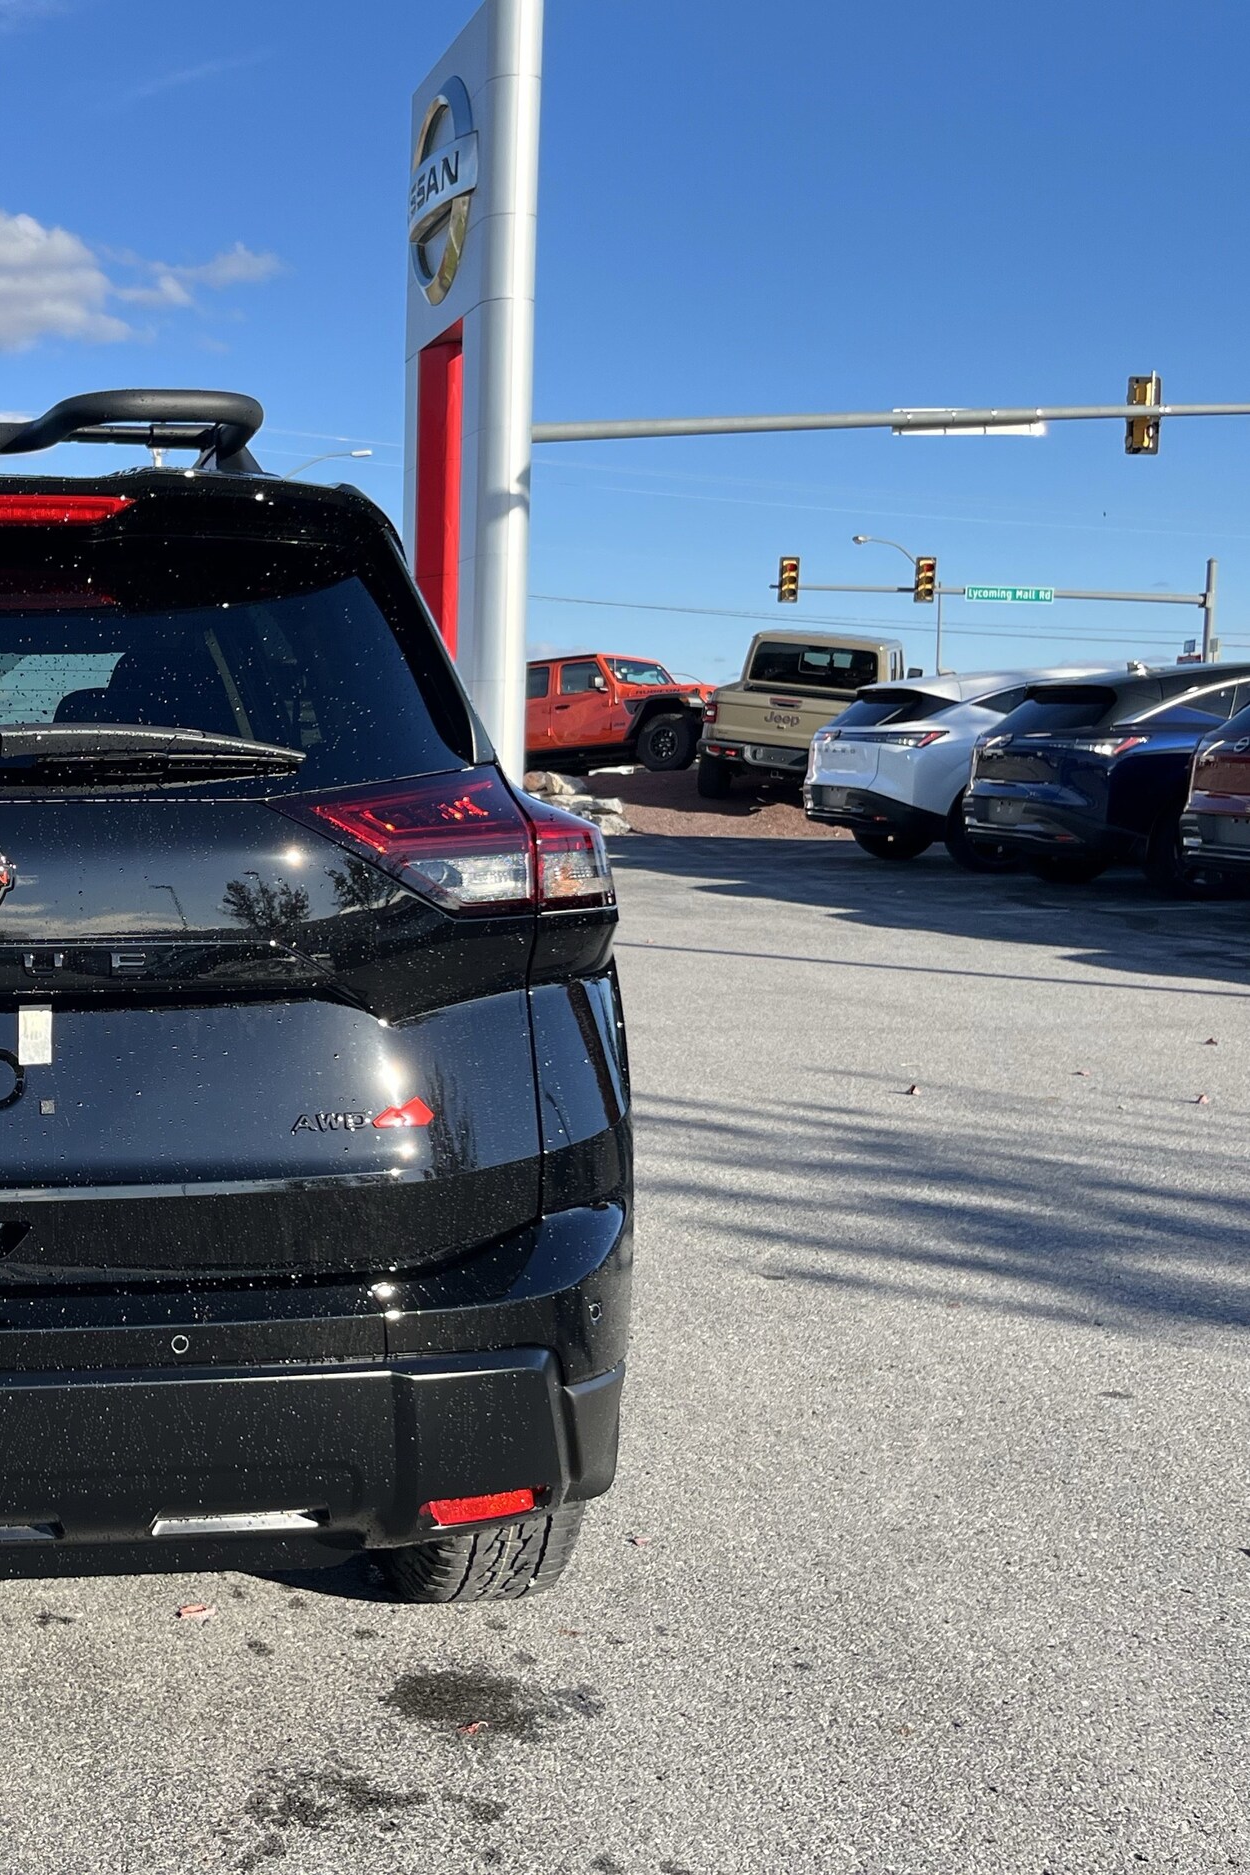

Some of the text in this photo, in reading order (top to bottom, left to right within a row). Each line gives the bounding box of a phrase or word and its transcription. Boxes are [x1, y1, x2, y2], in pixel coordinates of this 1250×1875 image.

[968, 588, 1052, 601] Lycoming Mall Rd
[763, 711, 800, 728] Jeep
[290, 1112, 369, 1135] AWD
